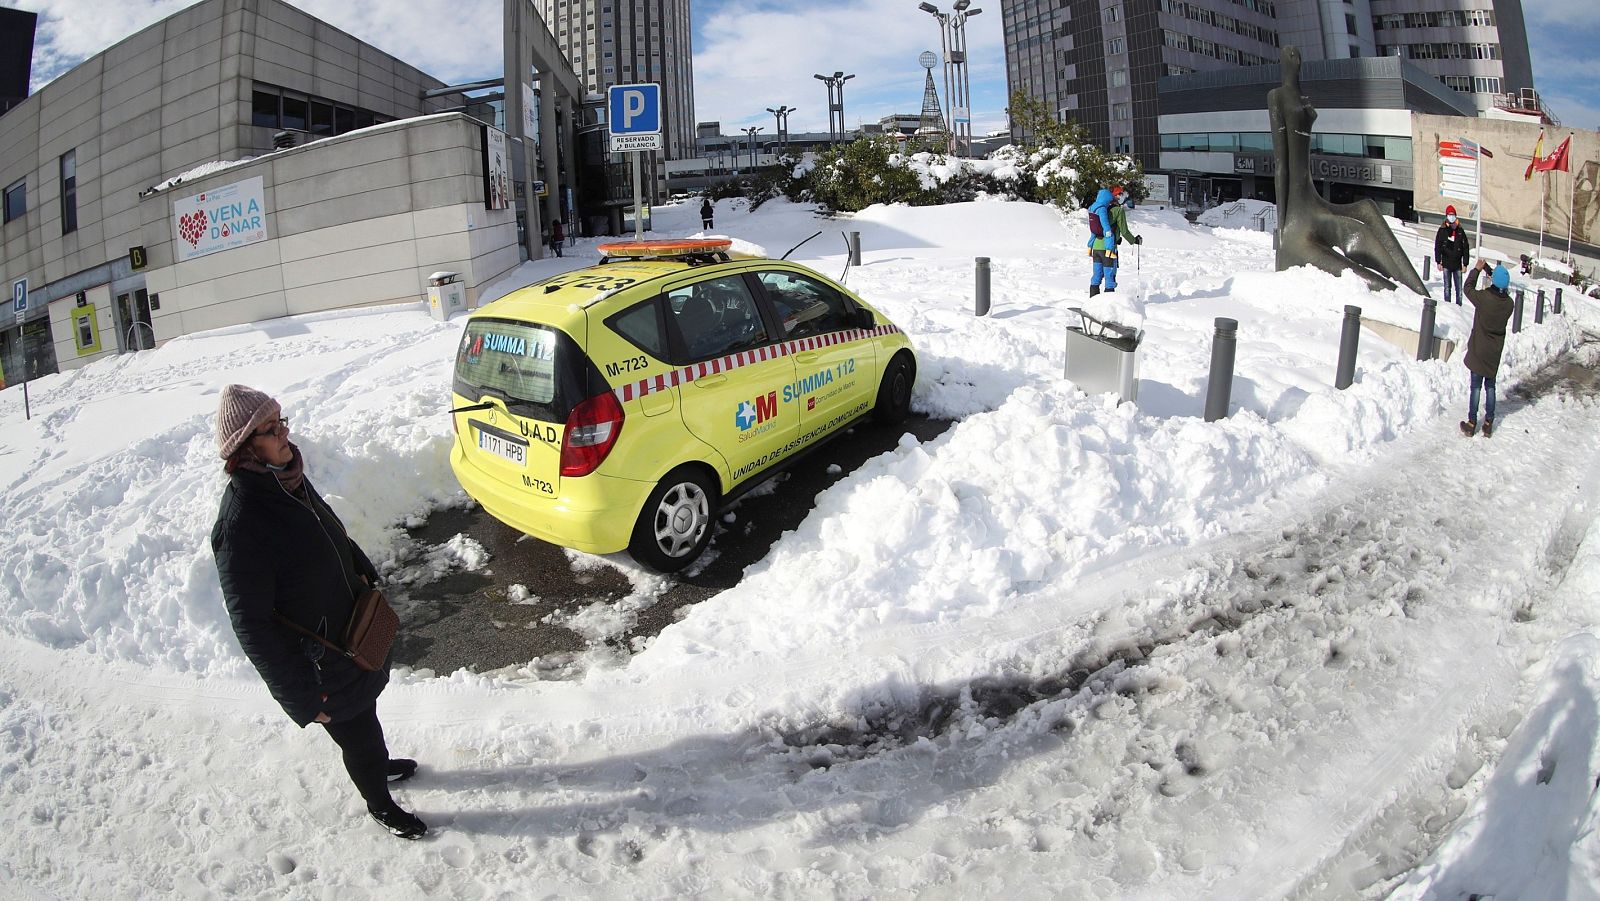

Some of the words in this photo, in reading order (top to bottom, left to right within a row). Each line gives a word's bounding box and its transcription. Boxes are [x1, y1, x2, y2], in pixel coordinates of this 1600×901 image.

[623, 90, 645, 128] P
[617, 142, 656, 151] BULANCIA
[1318, 159, 1376, 181] General
[209, 202, 242, 224] VEN
[247, 198, 260, 215] A
[211, 216, 261, 240] DONAR
[16, 283, 24, 309] P
[483, 332, 526, 356] SUMMA
[605, 355, 649, 378] M-723
[782, 367, 834, 403] SUMMA
[837, 358, 856, 379] 112
[755, 390, 778, 425] M
[520, 420, 561, 445] U.A.D.
[733, 455, 768, 480] UNIDAD
[769, 447, 782, 461] DE
[782, 423, 827, 455] ASISTENCIA
[827, 401, 869, 429] DOMICILIARIA
[484, 434, 501, 455] 1171
[505, 443, 523, 462] HPB
[522, 474, 554, 495] M-723
